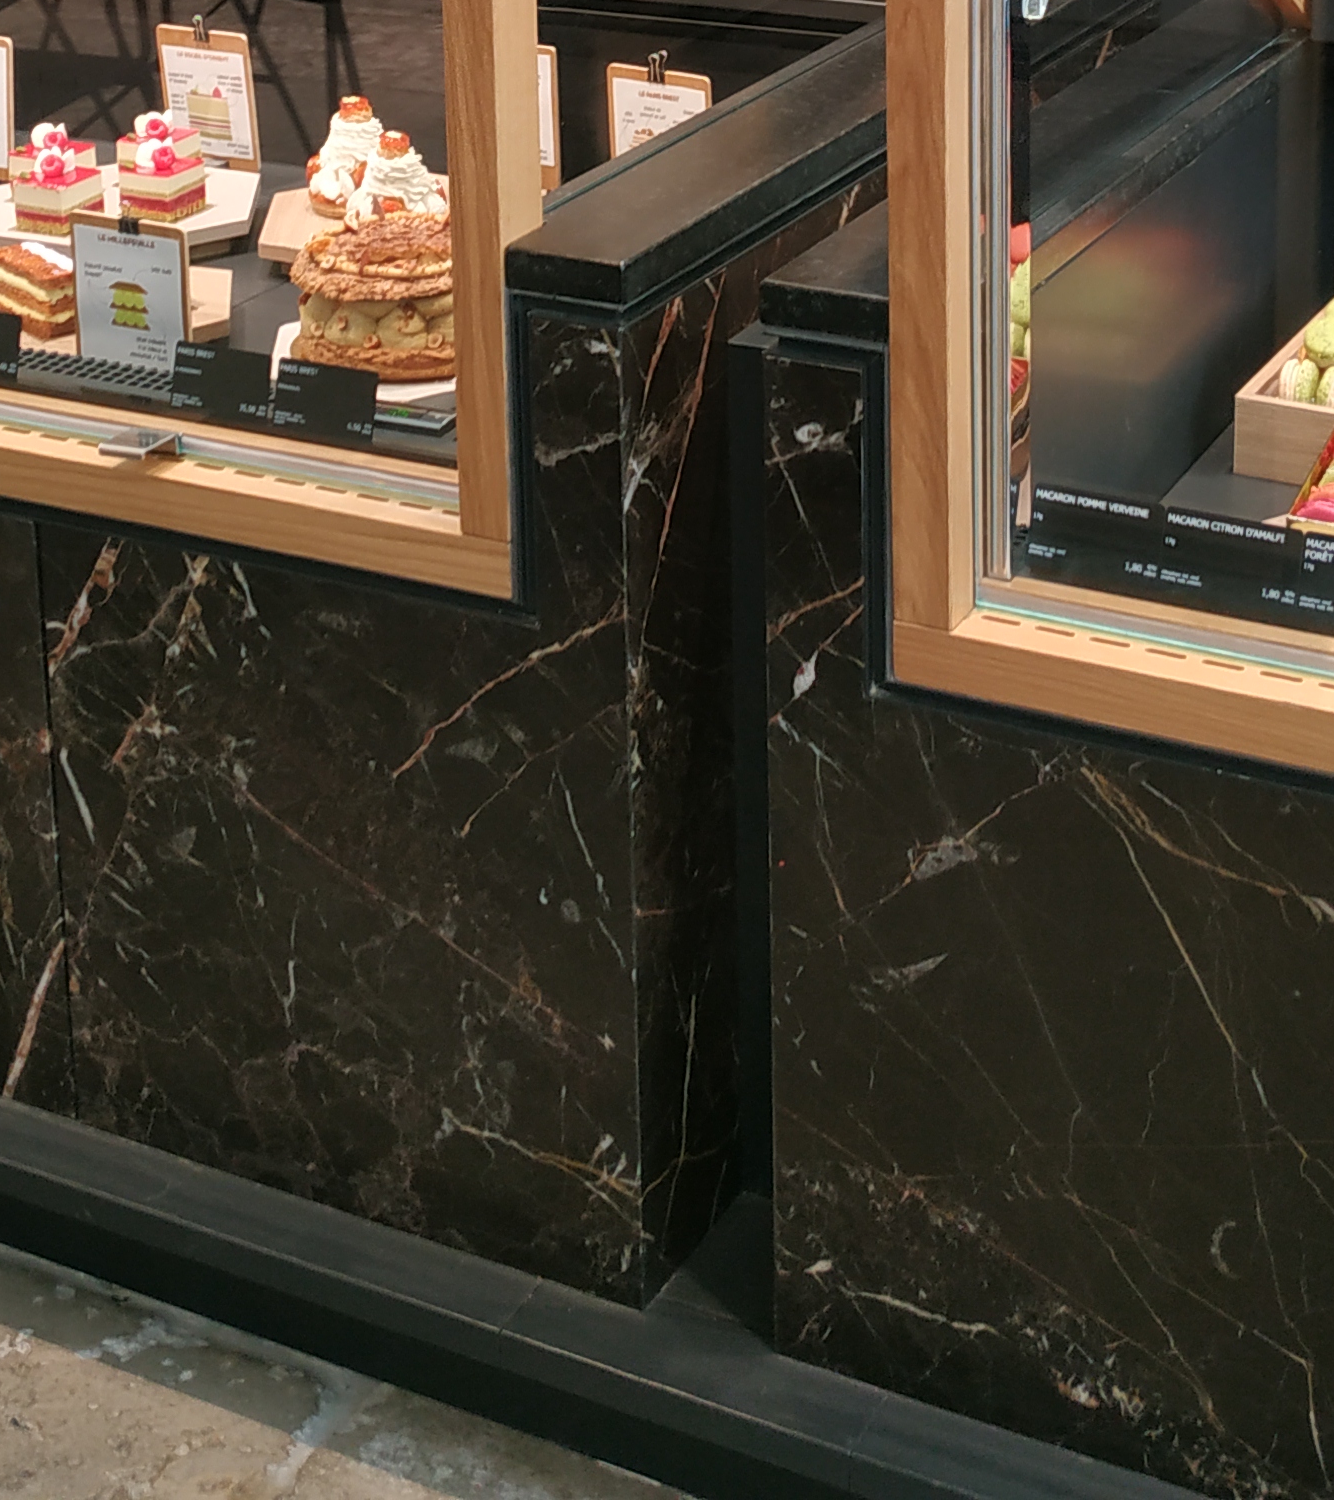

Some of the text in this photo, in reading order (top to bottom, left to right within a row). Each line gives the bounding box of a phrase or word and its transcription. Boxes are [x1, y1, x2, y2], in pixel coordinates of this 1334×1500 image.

[1036, 488, 1150, 519] MACARON POMME VERVEINE
[1167, 513, 1286, 544] MACARON CITRON D'AMALFI
